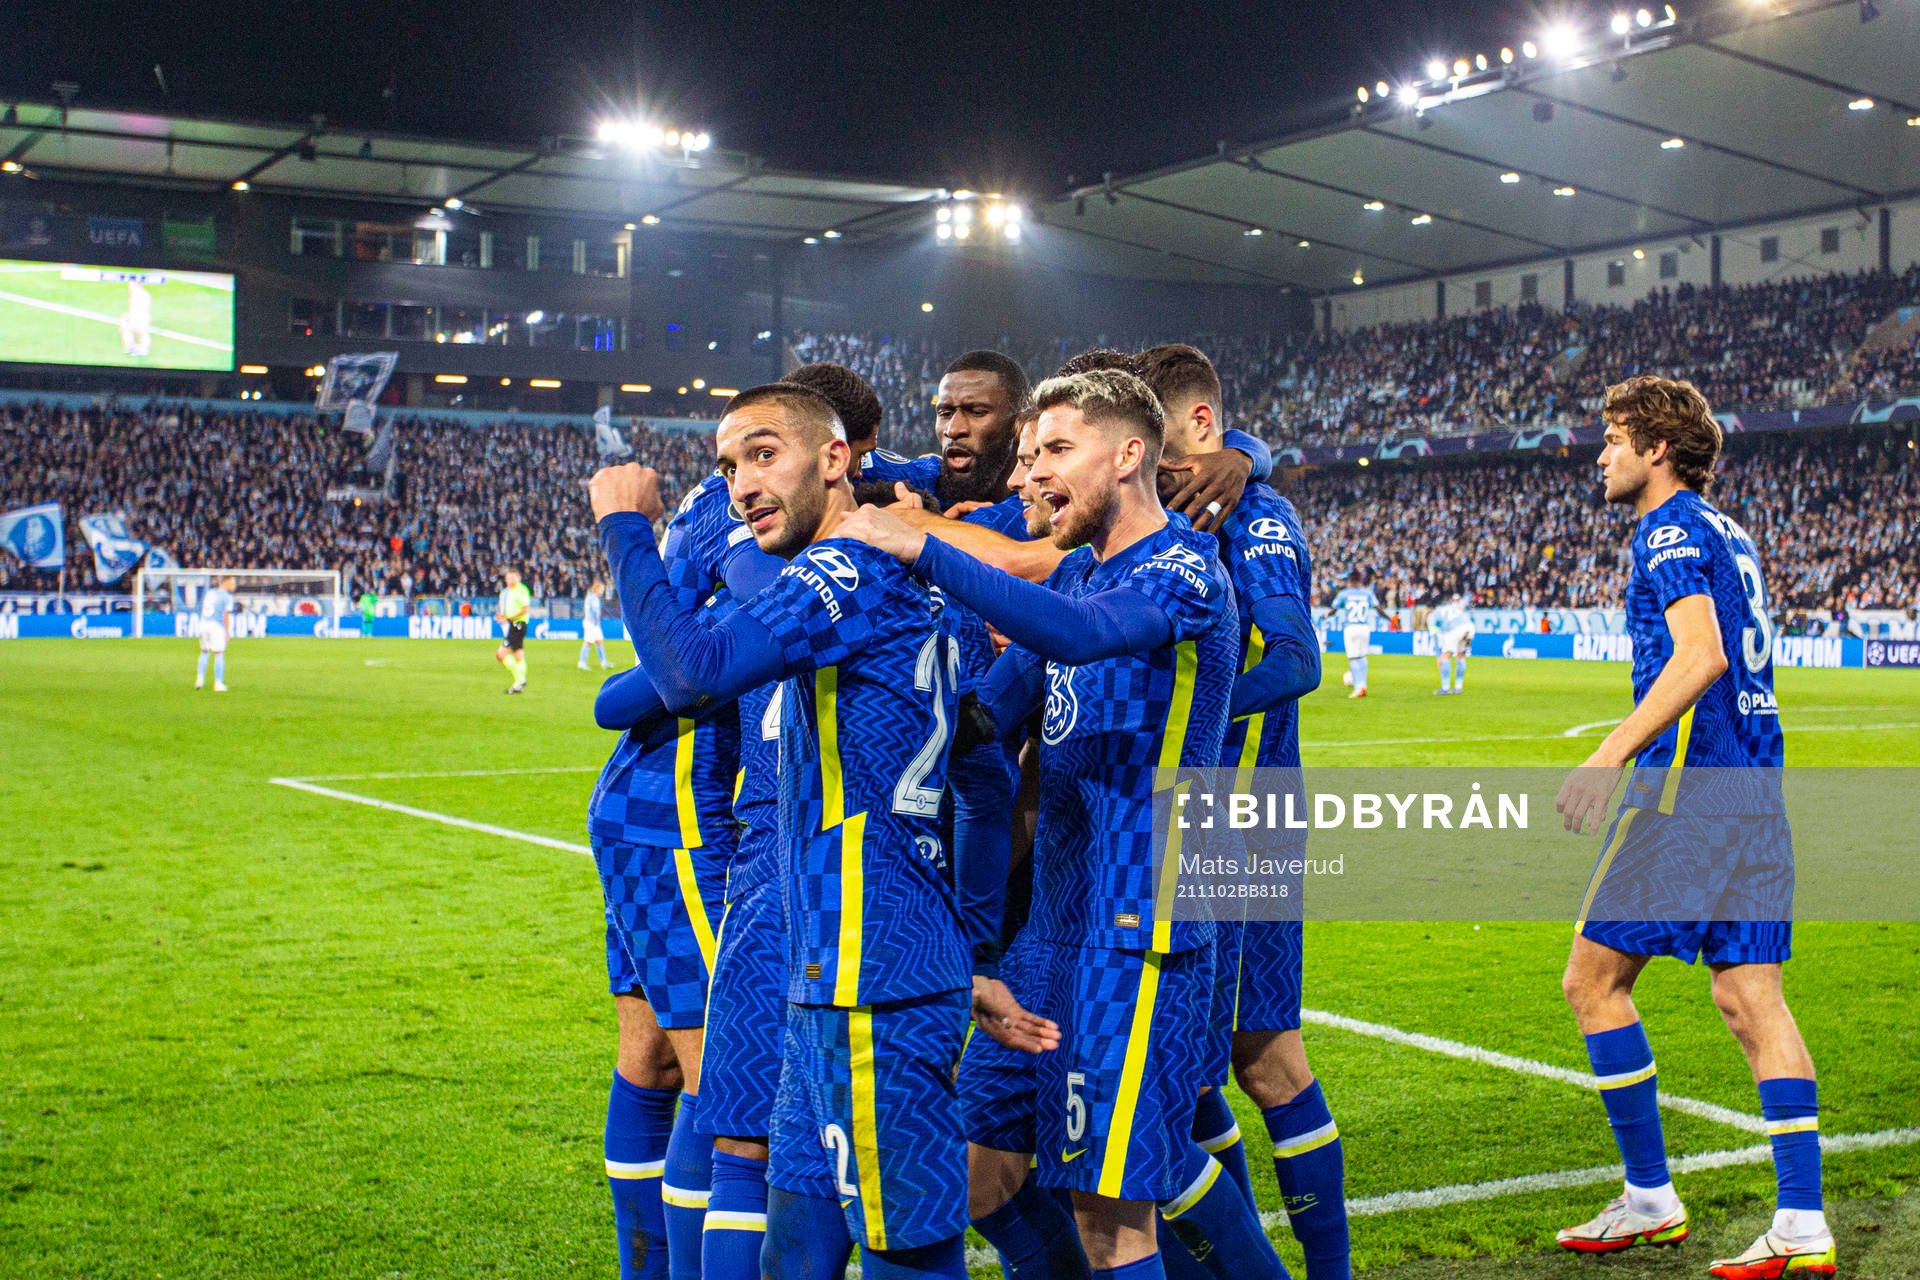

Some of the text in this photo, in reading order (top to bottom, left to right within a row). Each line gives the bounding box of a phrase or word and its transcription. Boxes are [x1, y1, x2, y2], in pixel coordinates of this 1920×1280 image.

[89, 230, 142, 247] UEFA
[1647, 546, 1700, 573] HYUNDAI
[1345, 601, 1369, 623] 20
[1735, 553, 1771, 673] 3
[408, 615, 492, 639] GAZPROM
[1772, 635, 1842, 668] AZPROM
[1887, 644, 1920, 664] UEF
[1066, 1072, 1086, 1142] 5
